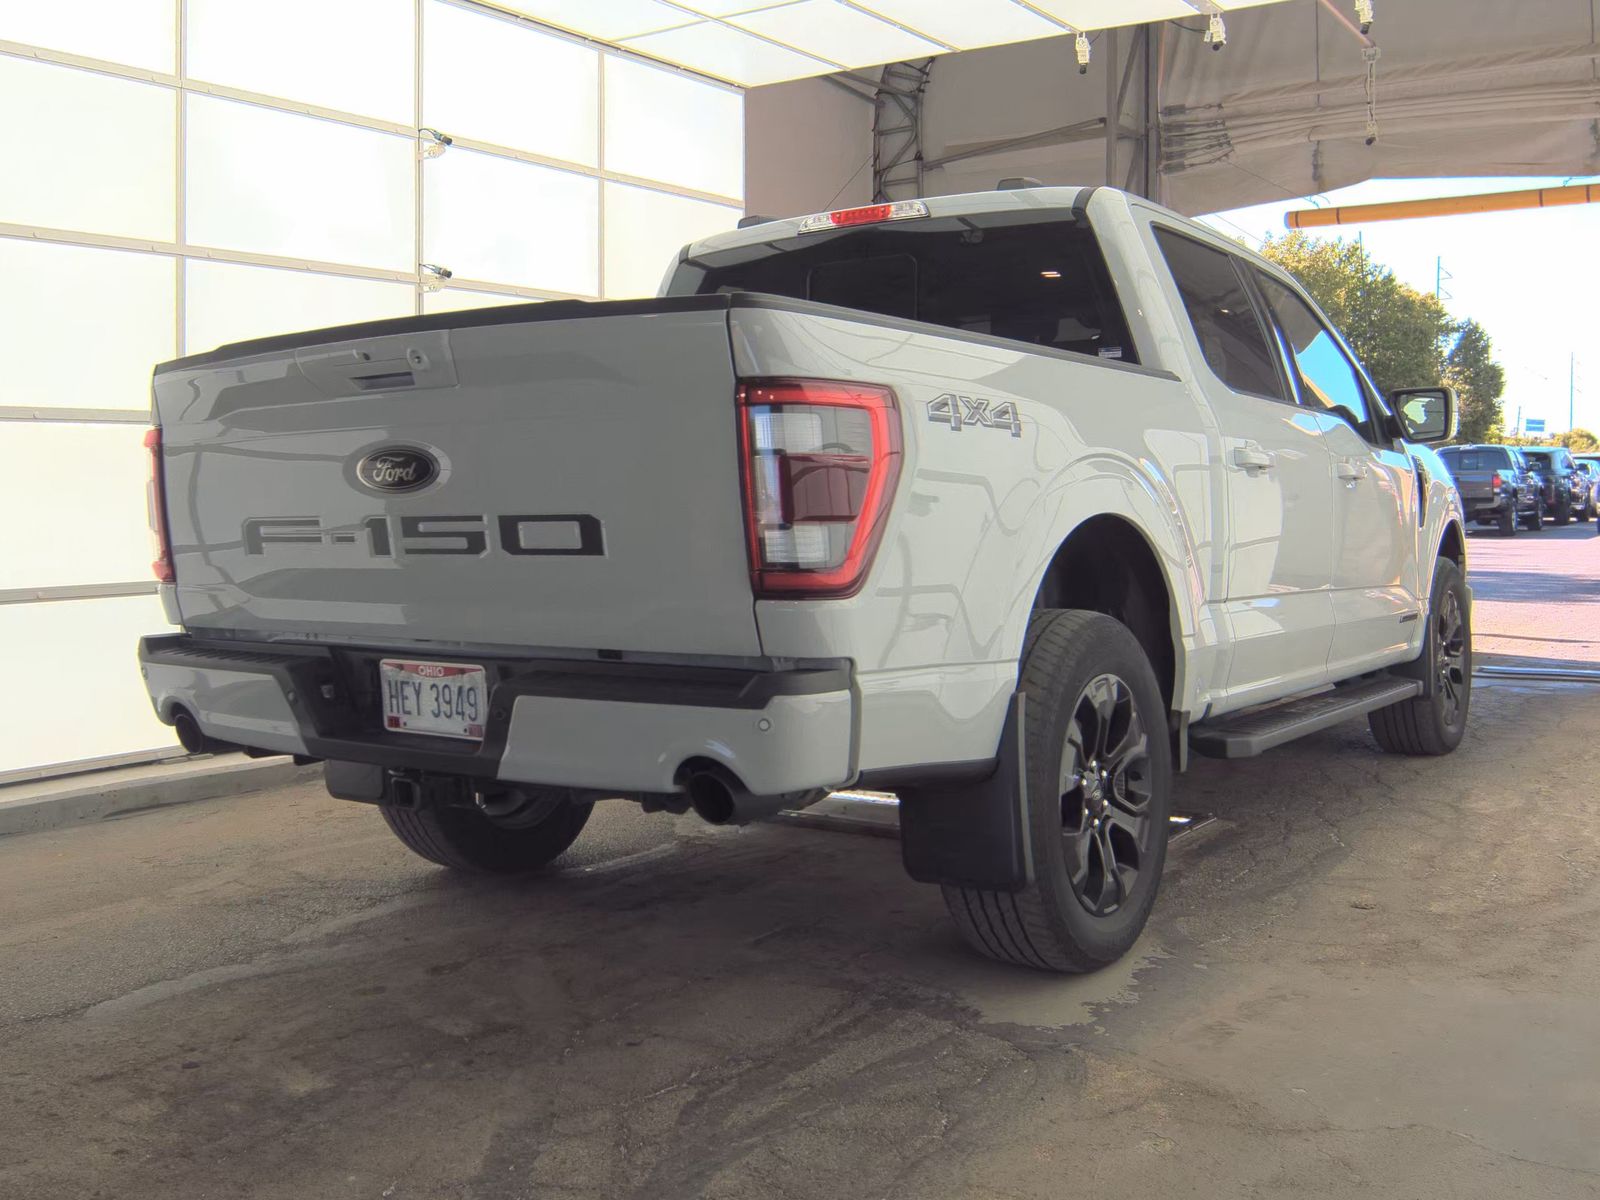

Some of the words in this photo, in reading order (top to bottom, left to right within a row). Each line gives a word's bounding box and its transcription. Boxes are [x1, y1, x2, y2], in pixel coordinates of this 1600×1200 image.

[373, 456, 416, 482] Ford
[243, 513, 607, 558] F-150
[418, 664, 445, 677] OHIO
[388, 680, 423, 716] HEY
[430, 683, 478, 721] 3949
